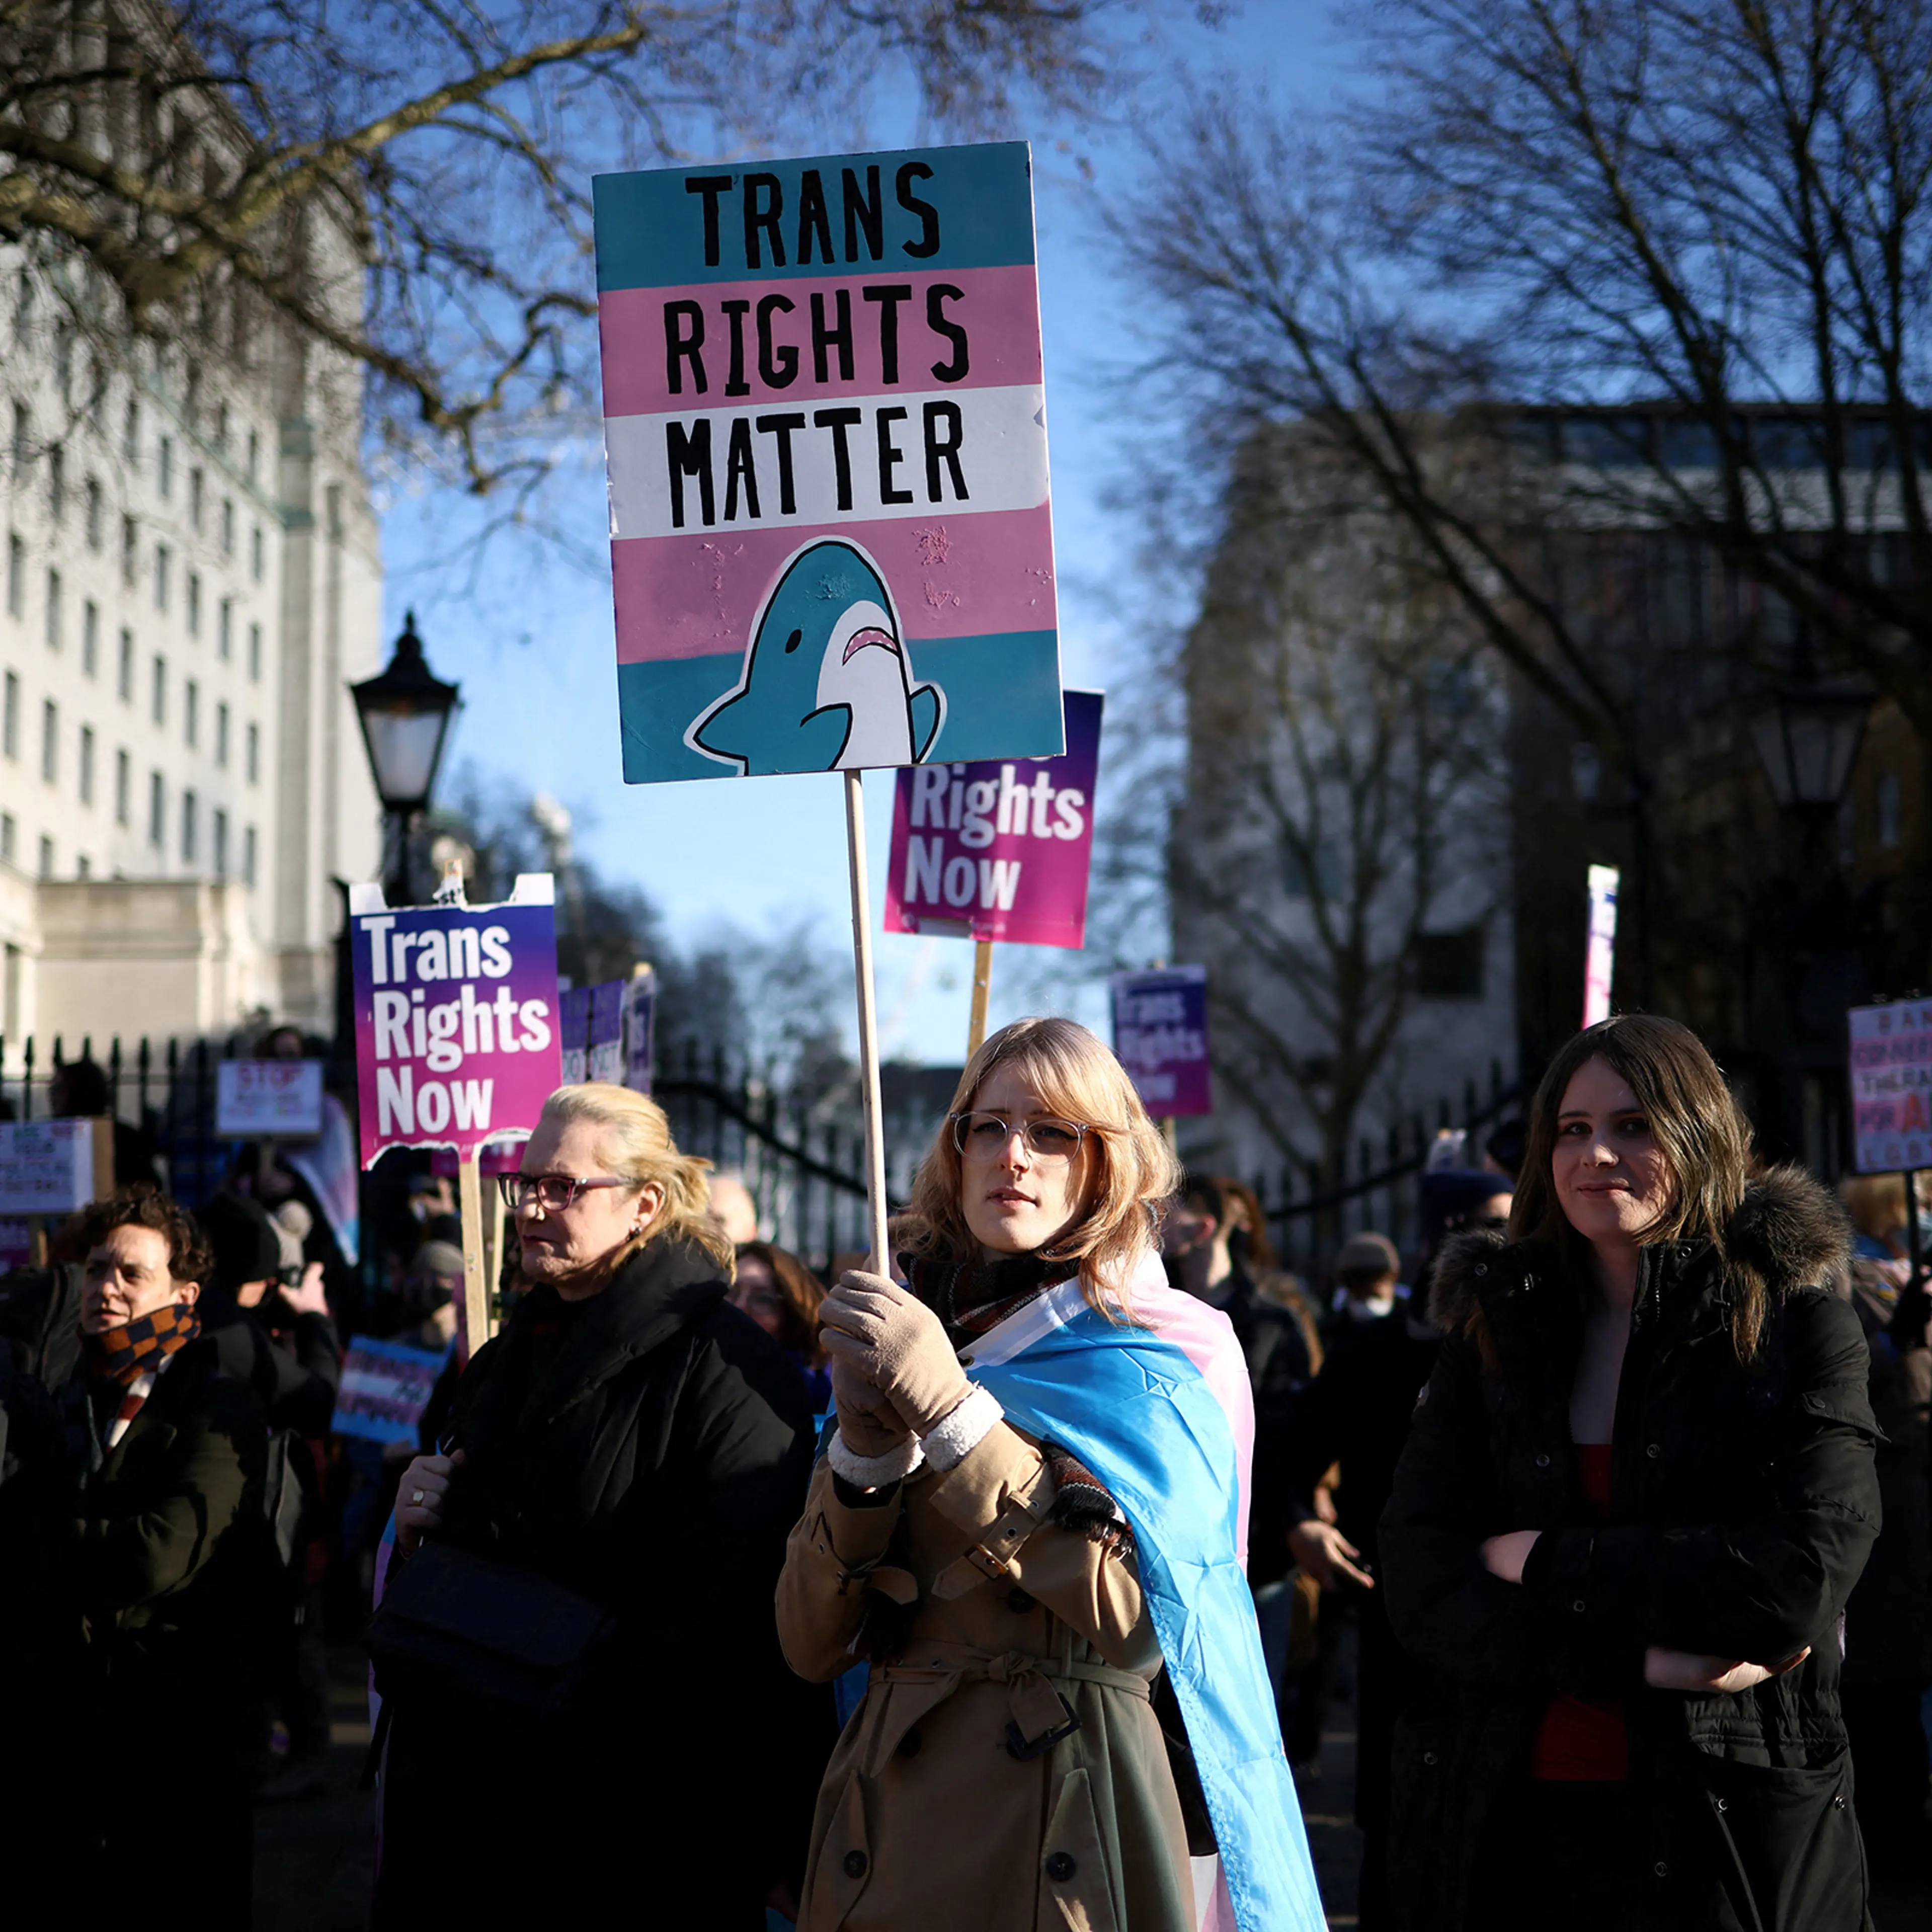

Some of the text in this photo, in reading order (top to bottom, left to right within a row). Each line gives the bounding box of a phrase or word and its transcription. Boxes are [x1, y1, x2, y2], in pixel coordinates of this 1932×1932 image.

[685, 162, 940, 269] TRANS
[664, 283, 970, 396] RIGHTS
[666, 400, 970, 528] MATTER
[910, 763, 1085, 849] Rights
[903, 835, 1022, 911] Now
[360, 915, 513, 985] Trans
[372, 983, 551, 1073] Rights
[236, 1058, 304, 1091] STOP
[376, 1064, 494, 1136] Now
